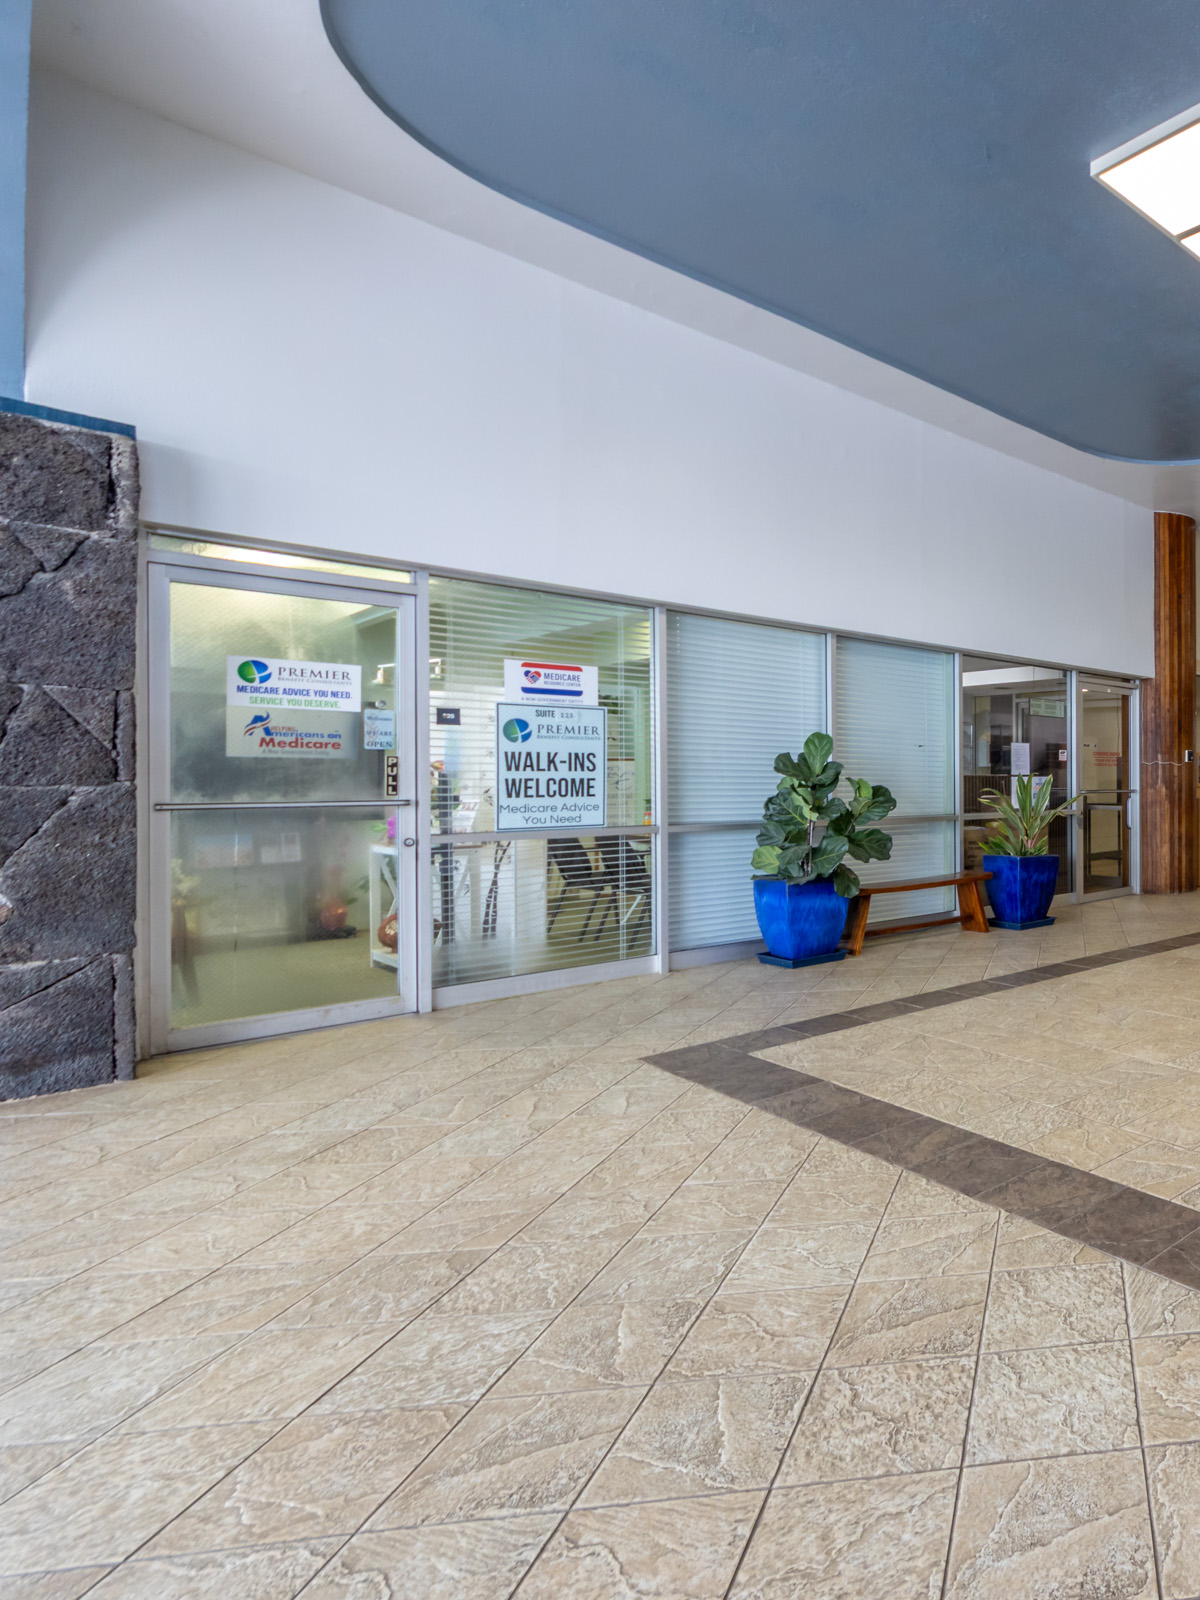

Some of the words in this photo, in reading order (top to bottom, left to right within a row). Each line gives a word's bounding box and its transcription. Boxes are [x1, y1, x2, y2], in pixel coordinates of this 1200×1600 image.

[278, 666, 351, 680] PREMIER
[544, 672, 581, 682] MEDICARE
[236, 685, 280, 696] MEDICARE
[282, 688, 311, 697] ADVICE
[314, 690, 329, 698] YOU
[331, 691, 353, 700] NEED.
[249, 696, 285, 706] SERVICE
[287, 698, 302, 707] YOU
[535, 709, 556, 718] SUITE
[537, 724, 600, 736] PREMIER
[259, 737, 342, 750] Medicare
[504, 751, 597, 772] WALK-INS
[387, 756, 398, 795] PULL
[504, 778, 596, 799] WELCOME
[499, 803, 558, 814] Medicare
[560, 802, 600, 813] Advice
[522, 815, 547, 825] You
[549, 814, 582, 824] Need
